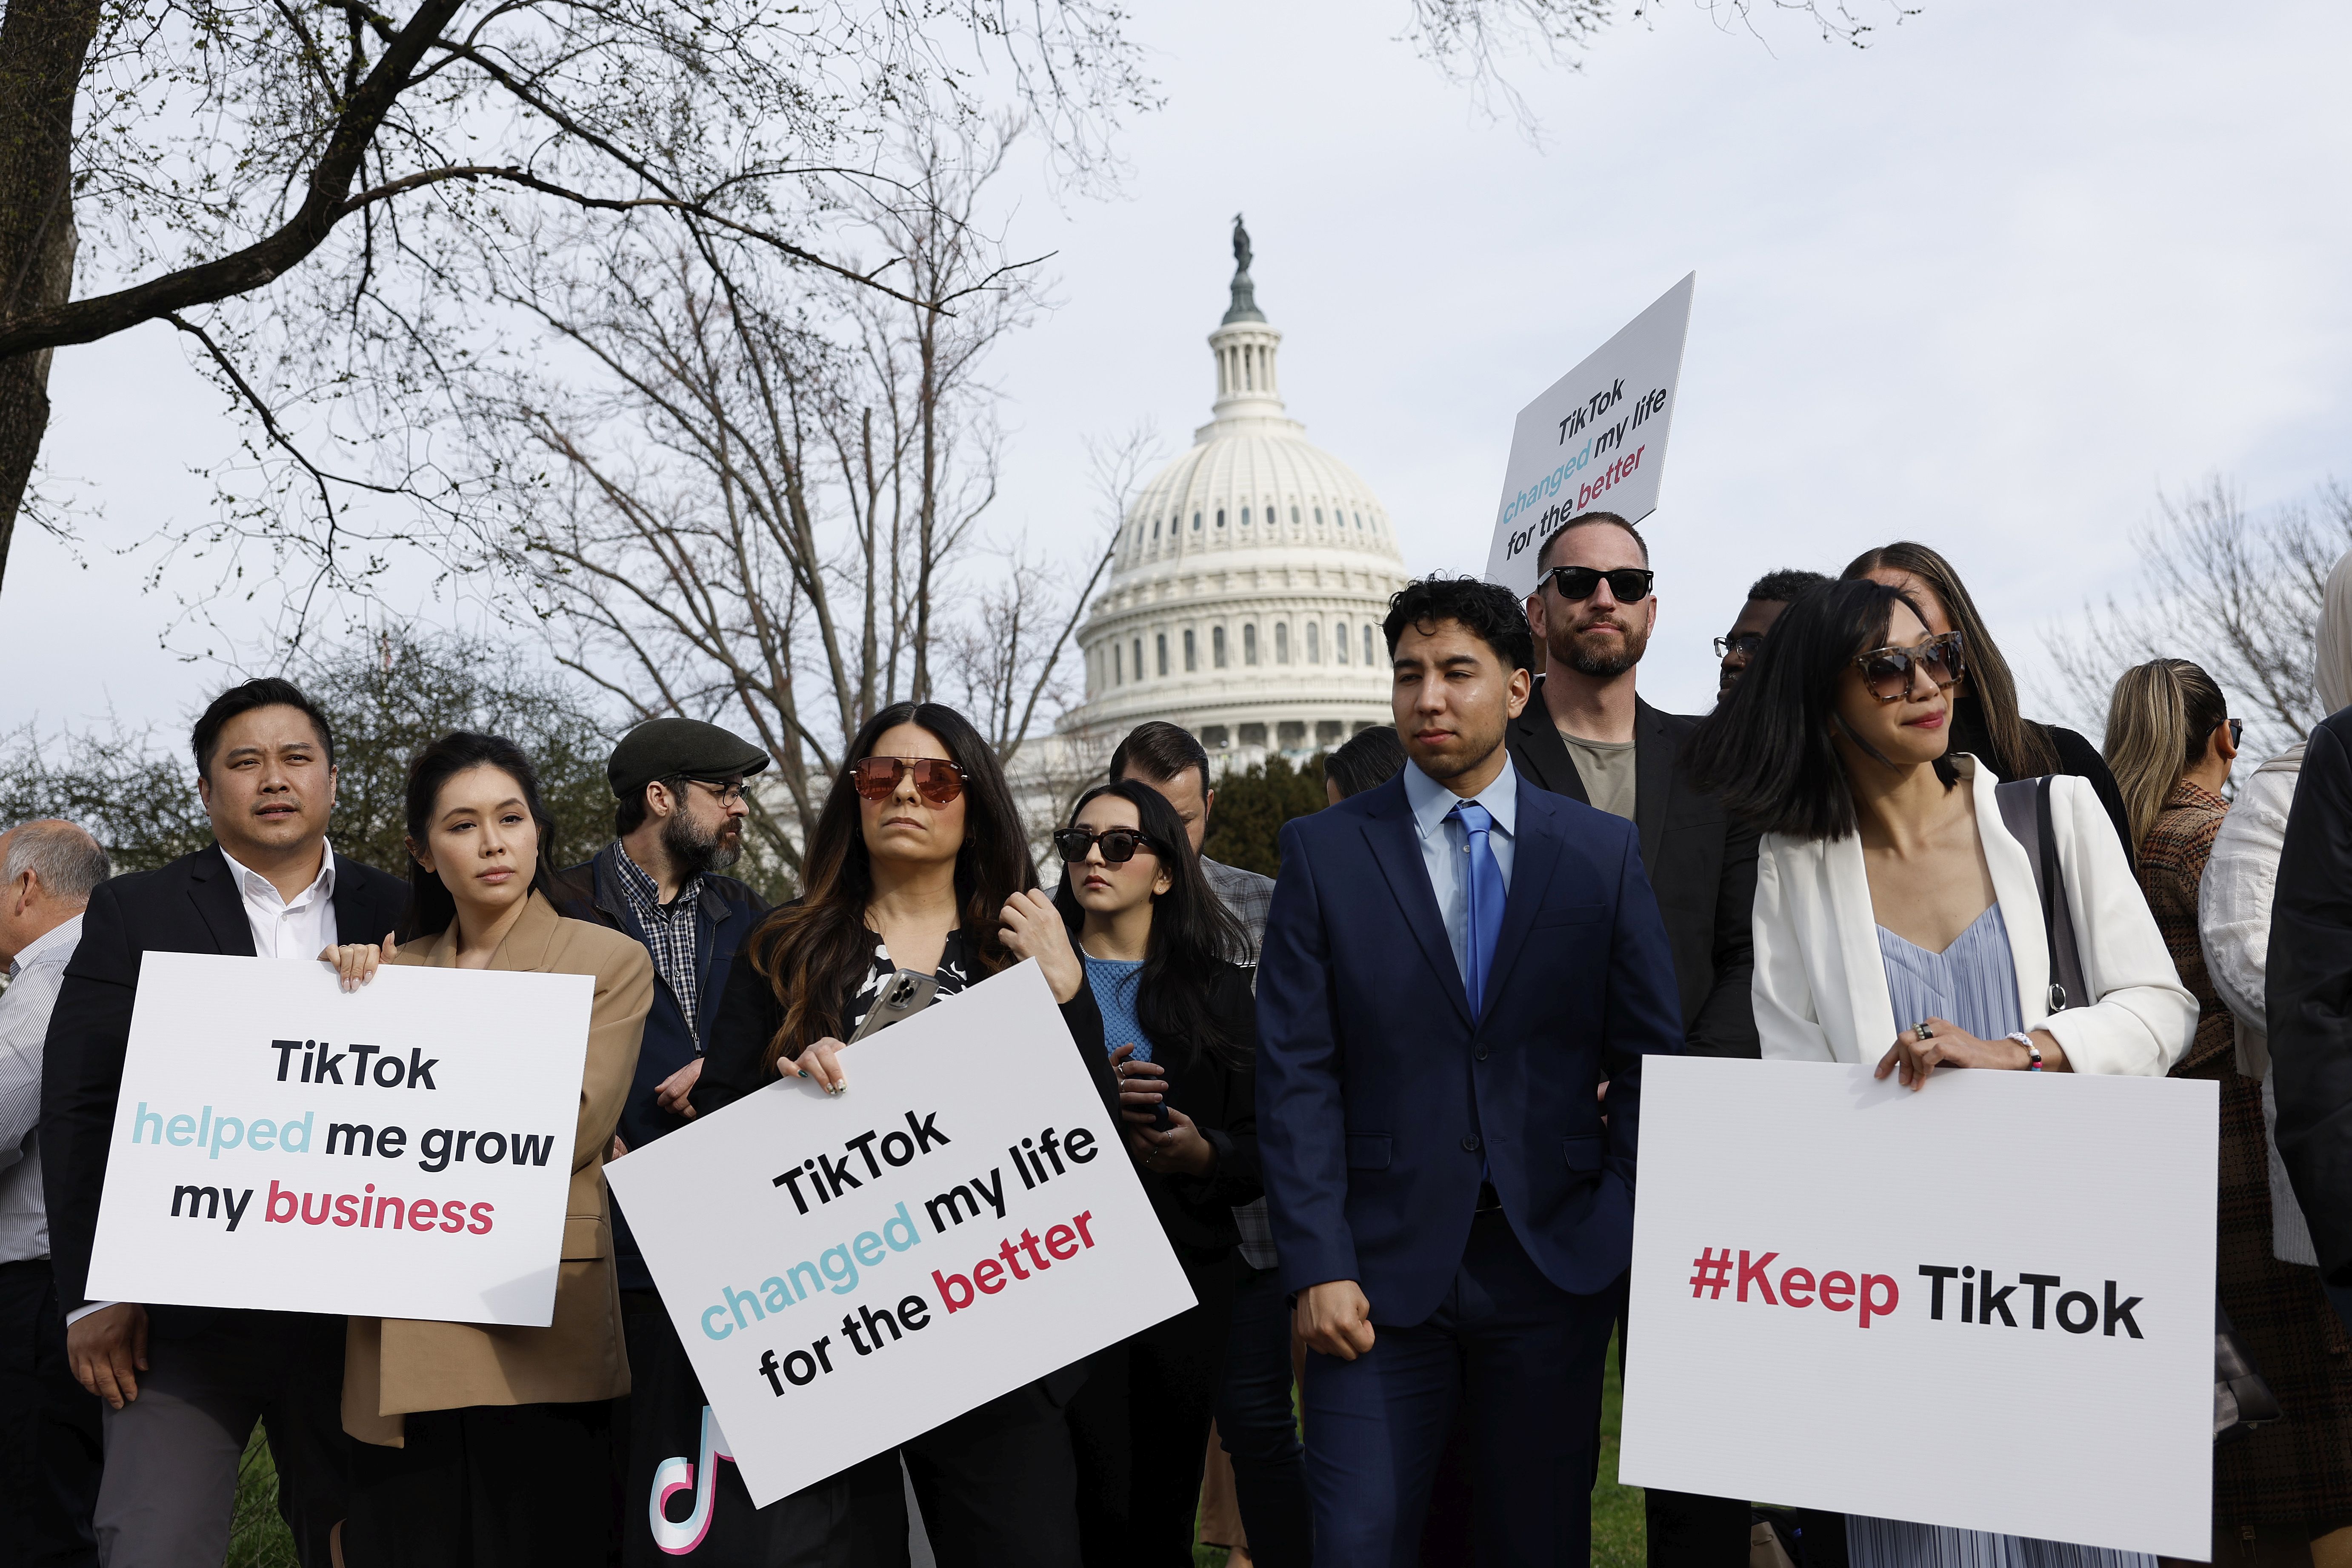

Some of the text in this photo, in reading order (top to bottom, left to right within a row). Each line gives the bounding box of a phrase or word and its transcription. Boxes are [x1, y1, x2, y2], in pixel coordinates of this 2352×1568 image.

[1503, 388, 1666, 524] changed my life
[1559, 377, 1626, 446] TikTok
[1506, 444, 1646, 561] for the better
[271, 1039, 440, 1090] TikTok
[132, 1102, 555, 1173] helped me grow
[772, 1110, 952, 1216] TikTok
[170, 1180, 495, 1235] my business
[701, 1127, 1098, 1340] changed my life
[758, 1209, 1095, 1398] for the better
[1689, 1247, 2144, 1340] #Keep TikTok
